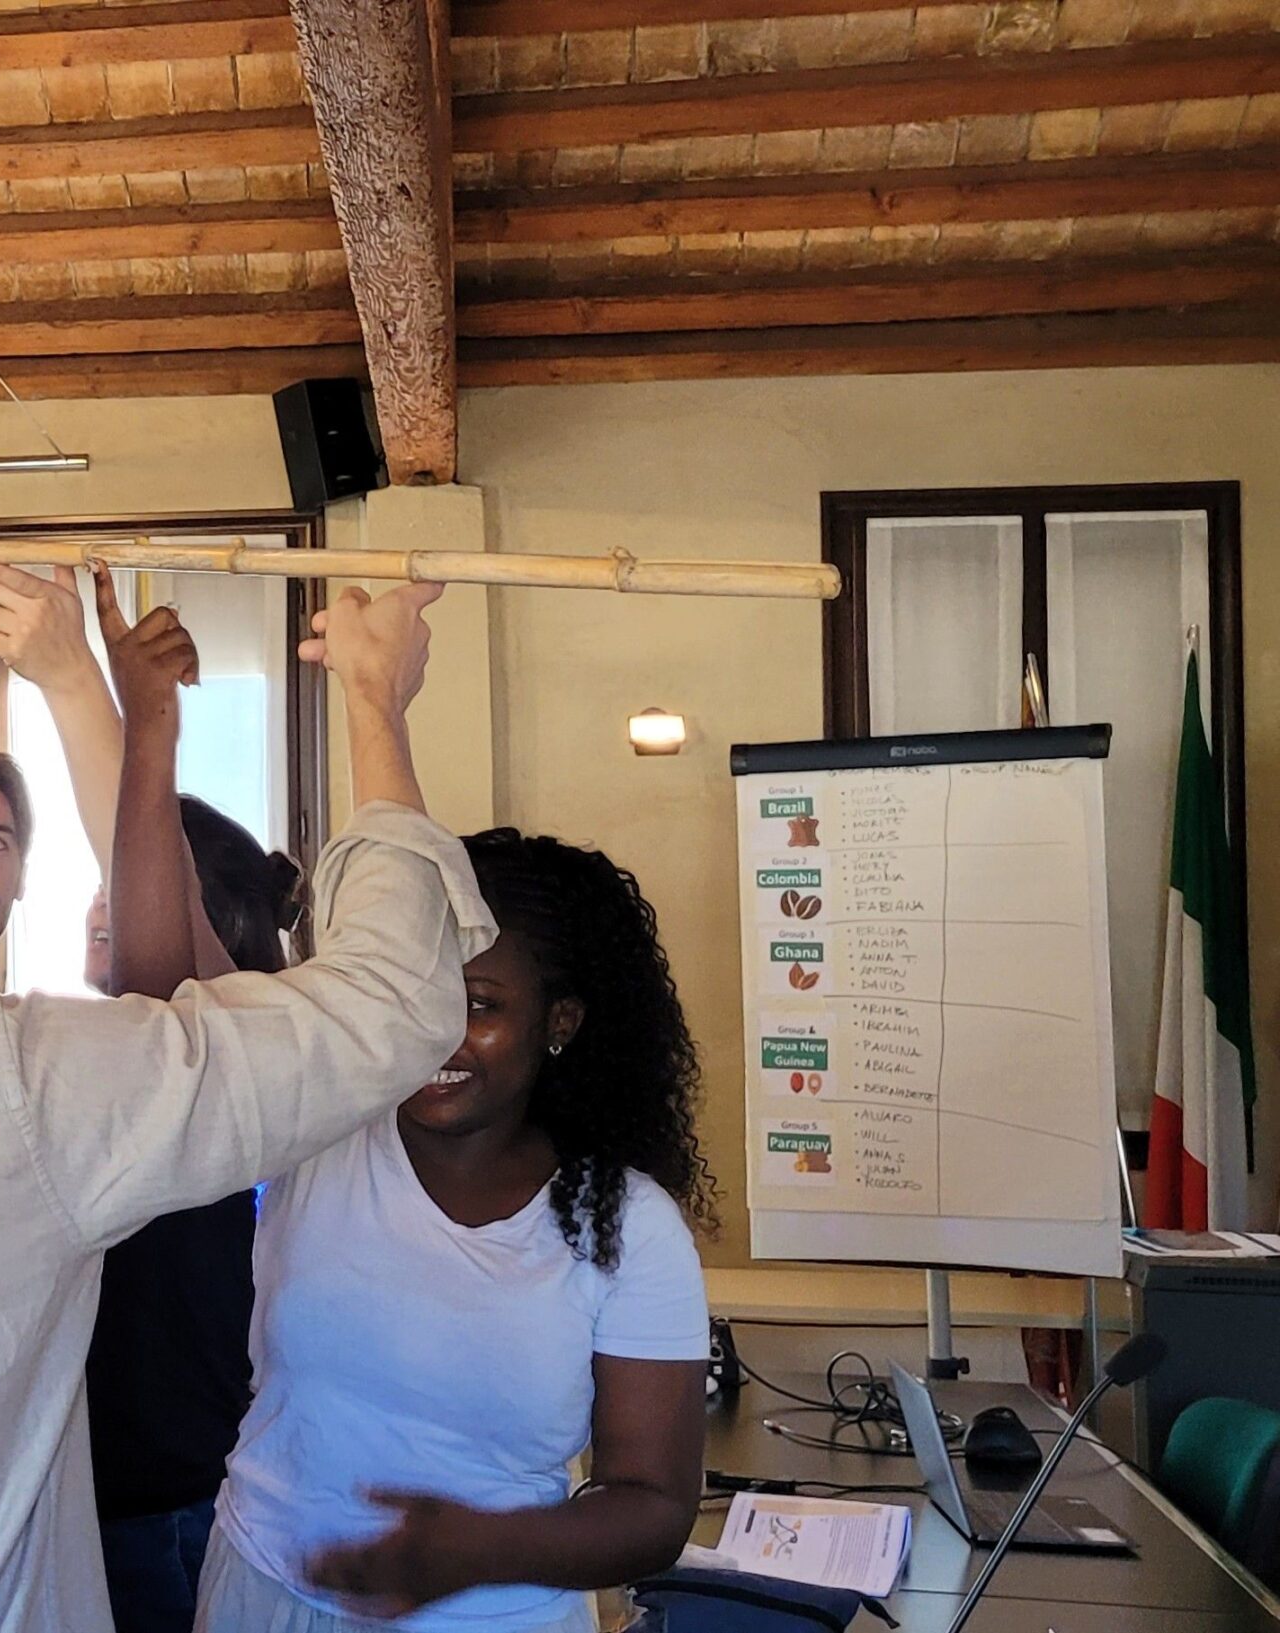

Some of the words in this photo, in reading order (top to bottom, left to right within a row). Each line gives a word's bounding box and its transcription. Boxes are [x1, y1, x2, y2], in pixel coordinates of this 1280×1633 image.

[768, 786, 798, 796] Group
[767, 801, 806, 815] Brazil
[852, 830, 900, 843] LUCAS
[772, 858, 799, 867] Group
[758, 872, 820, 885] Colombia
[855, 900, 925, 913] FABIANA
[778, 930, 807, 940] Group
[858, 939, 909, 950] NADIM
[774, 945, 820, 959] Ghana
[860, 952, 895, 963] ANNA
[859, 965, 907, 978] ANTON
[861, 979, 905, 993] DAVID
[777, 1025, 806, 1036] Group
[763, 1040, 798, 1053] Papua
[800, 1041, 827, 1053] New
[863, 1039, 924, 1057] PAULINA
[774, 1055, 815, 1067] Guinea
[864, 1058, 917, 1074] ABIGAIL
[780, 1121, 810, 1131] Group
[860, 1129, 899, 1144] WILL
[769, 1136, 830, 1153] Paraguay
[862, 1148, 892, 1161] ANNA
